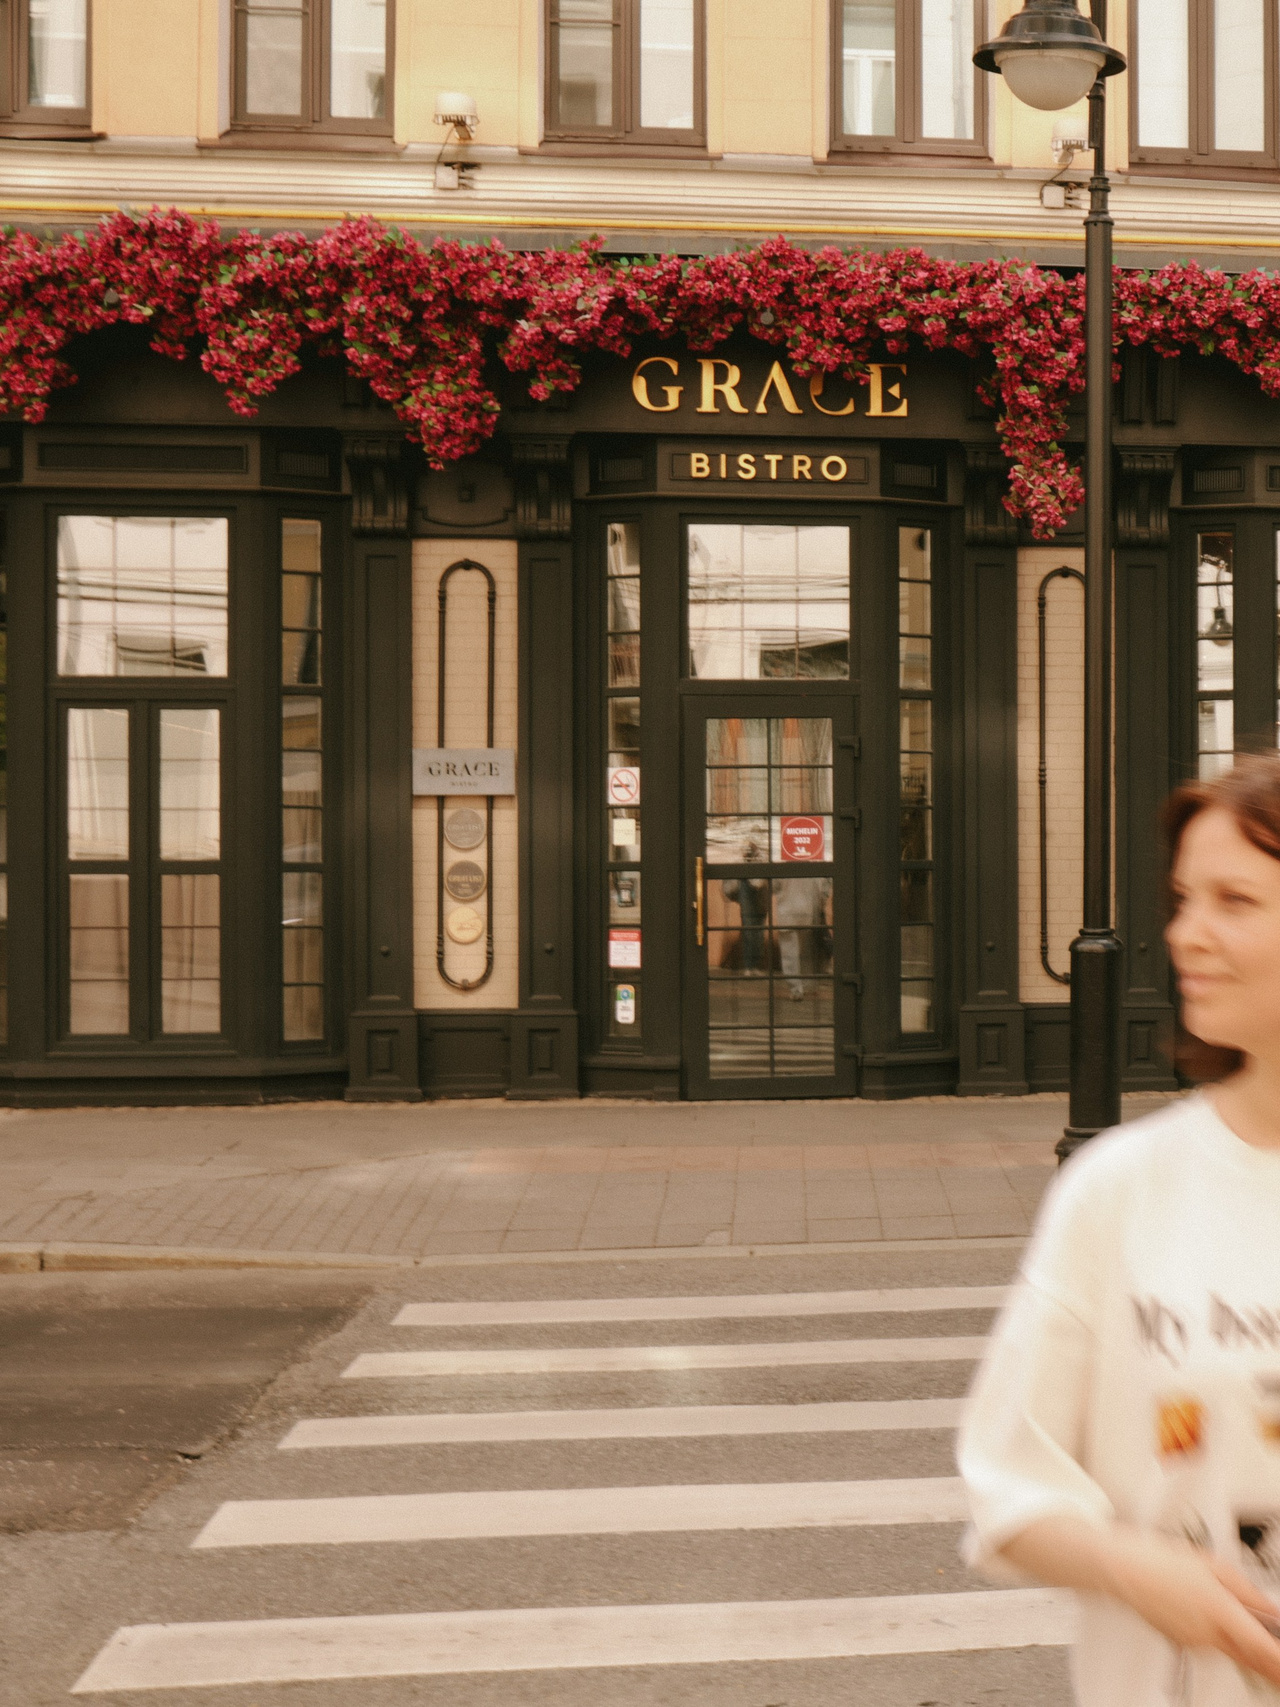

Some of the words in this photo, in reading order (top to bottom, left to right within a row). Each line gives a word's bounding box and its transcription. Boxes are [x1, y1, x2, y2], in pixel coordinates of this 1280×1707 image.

[632, 356, 908, 417] GRACE
[690, 453, 848, 482] BISTRO
[428, 762, 500, 776] GRACE
[786, 827, 819, 835] MICHELIN
